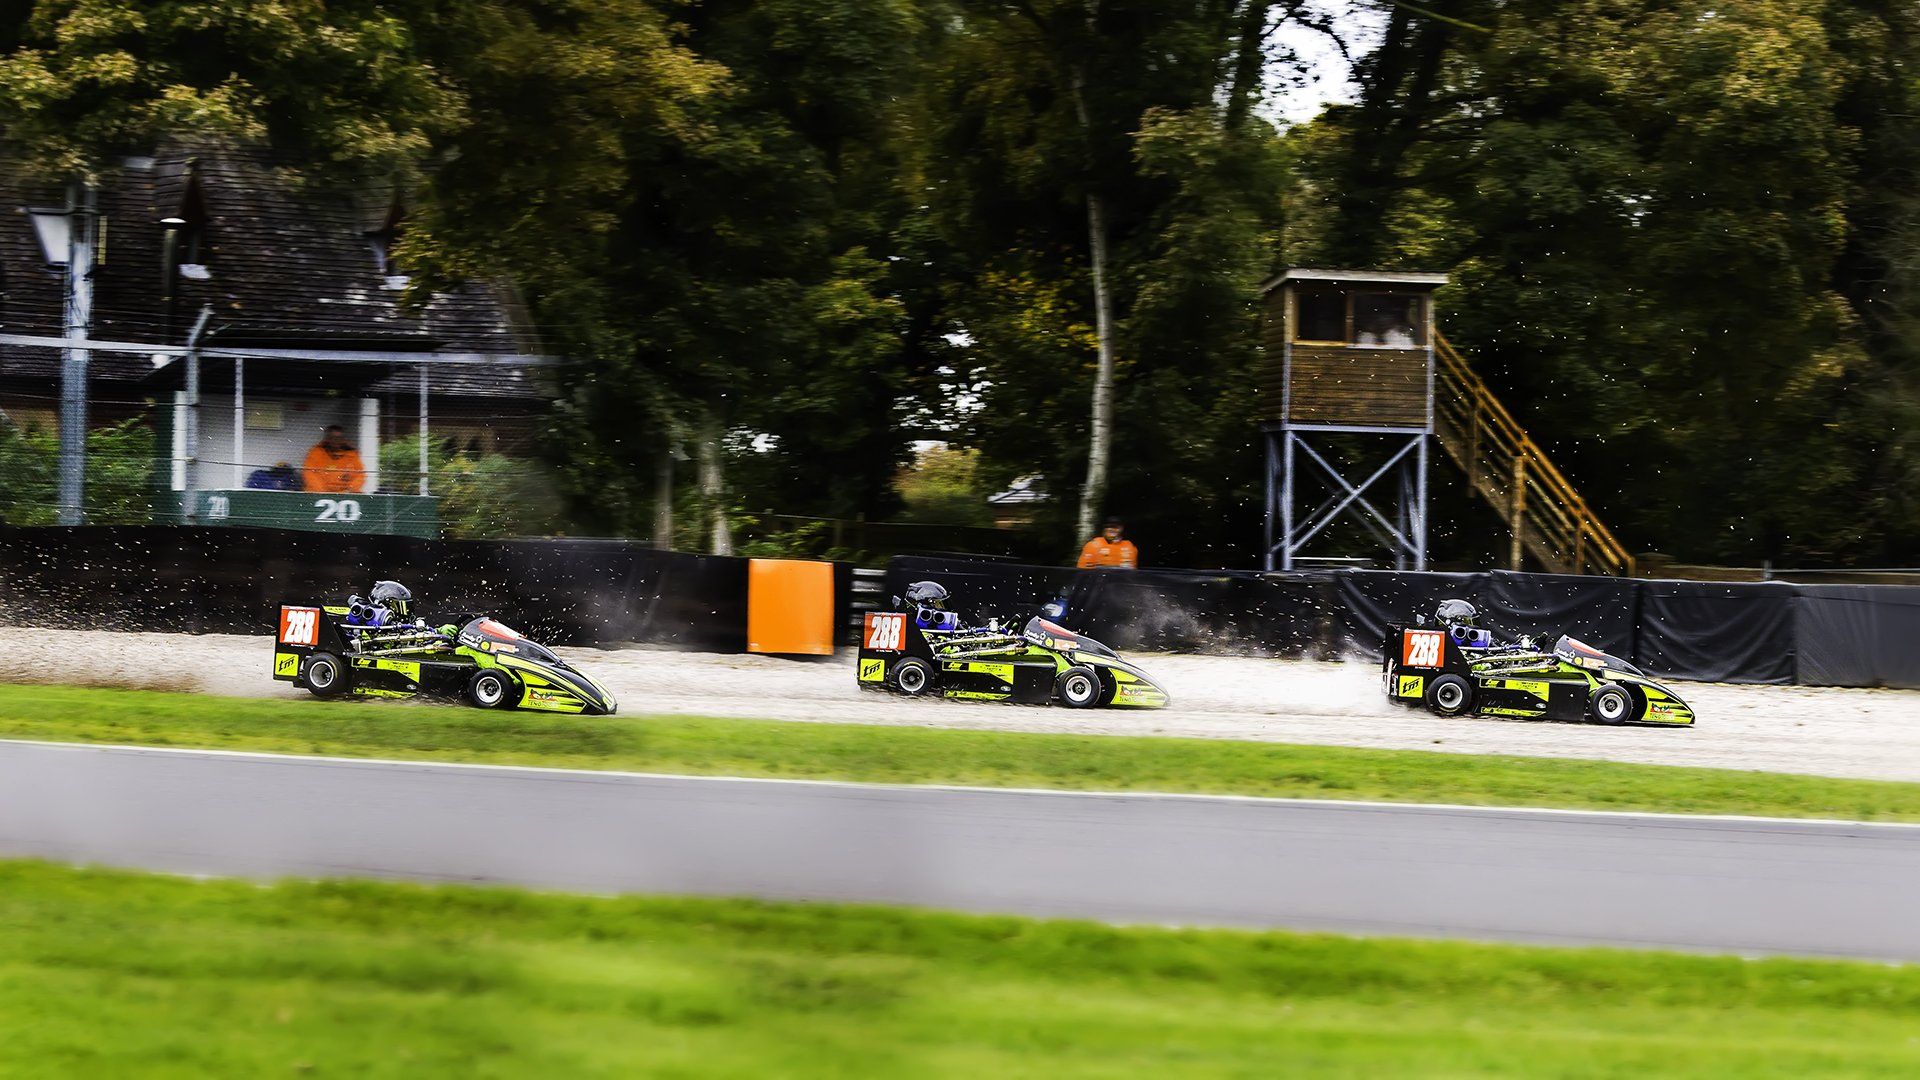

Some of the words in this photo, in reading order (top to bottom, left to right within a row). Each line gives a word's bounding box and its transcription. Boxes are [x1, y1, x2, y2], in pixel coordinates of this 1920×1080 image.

[314, 499, 361, 522] 20
[285, 610, 316, 644] 288
[869, 616, 902, 649] 288
[1408, 634, 1440, 667] 288
